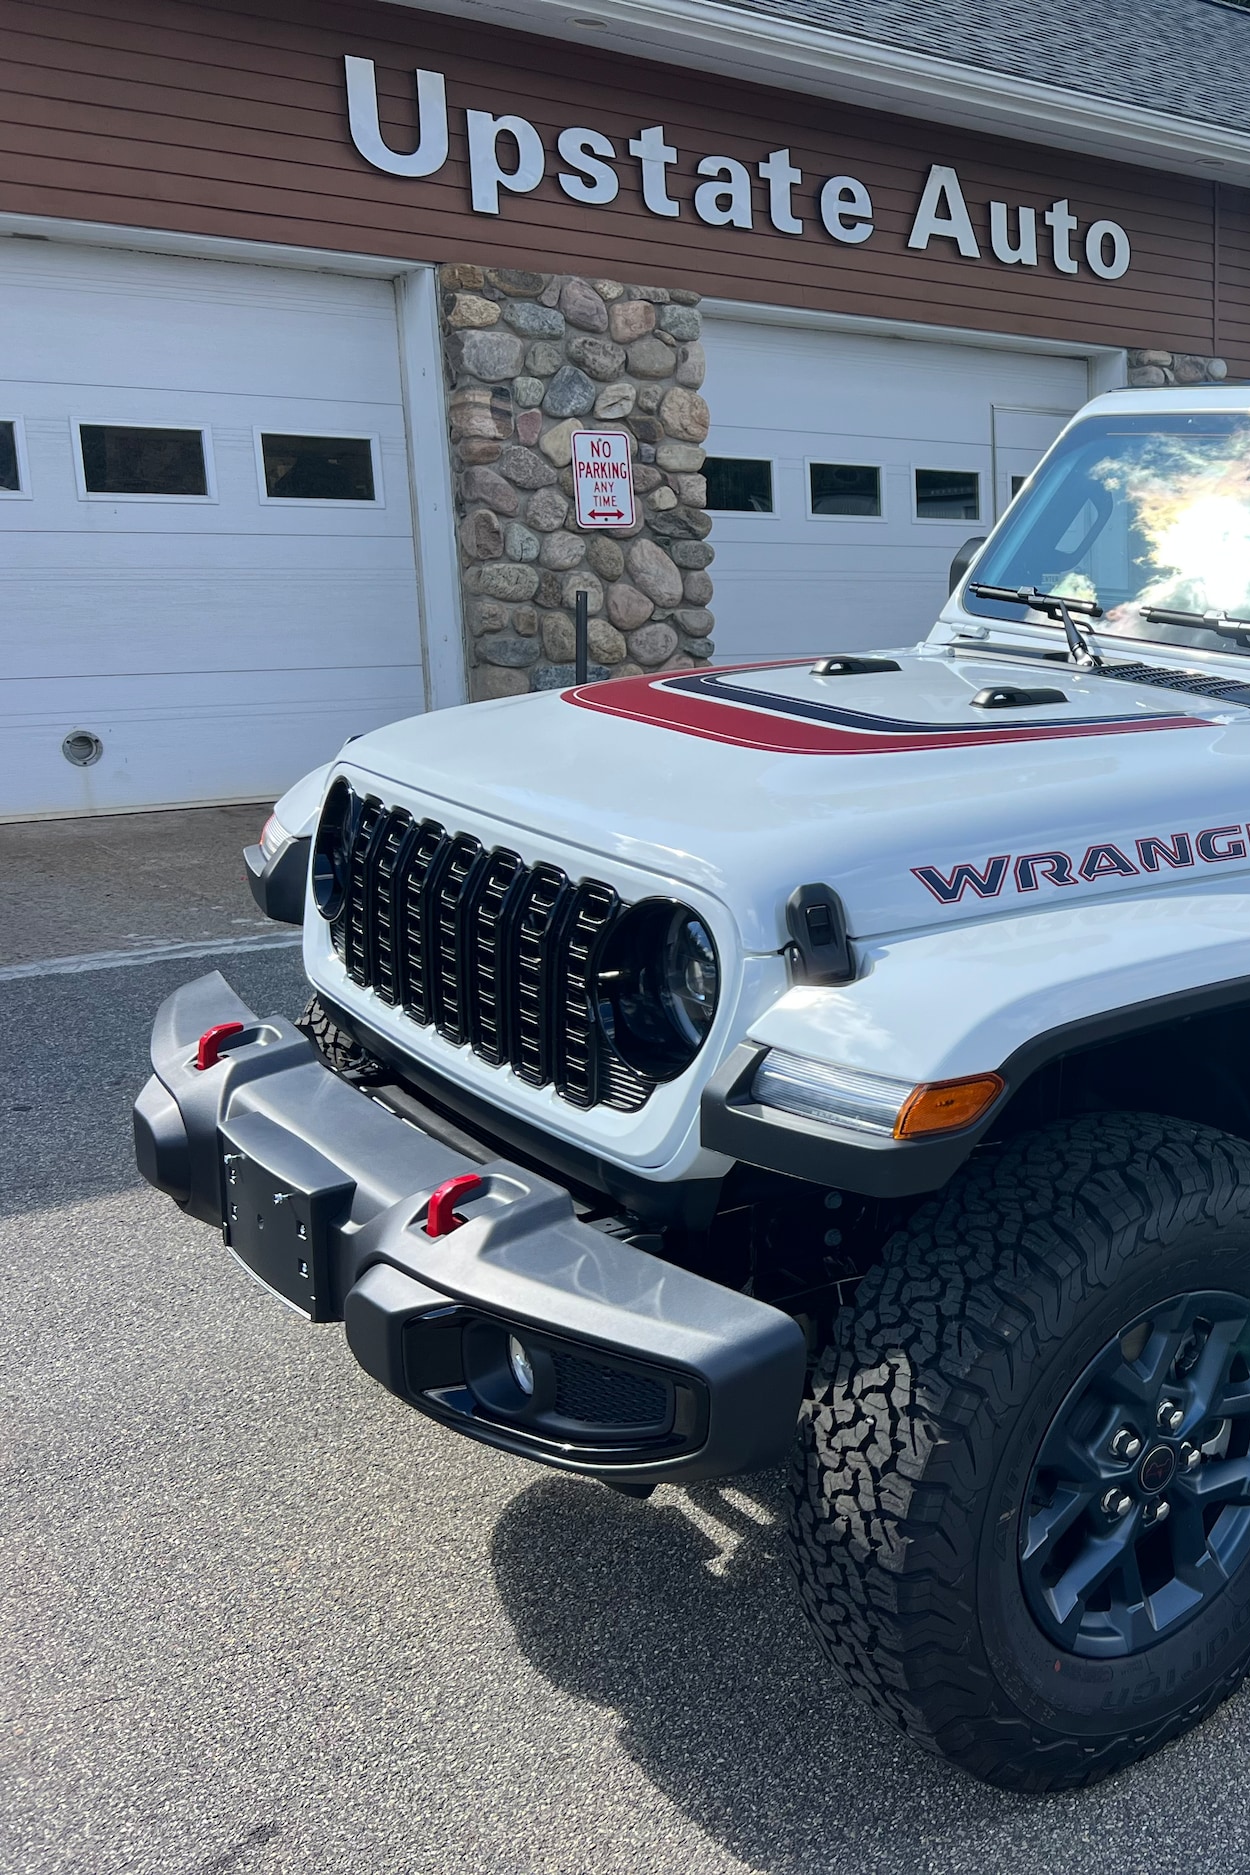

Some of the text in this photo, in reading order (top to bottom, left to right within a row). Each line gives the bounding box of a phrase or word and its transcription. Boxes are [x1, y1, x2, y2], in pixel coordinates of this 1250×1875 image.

[344, 54, 1132, 281] Upstate Auto
[591, 441, 611, 458] NO
[578, 461, 627, 479] PARKING
[594, 482, 614, 493] ANY
[593, 495, 617, 507] TIME
